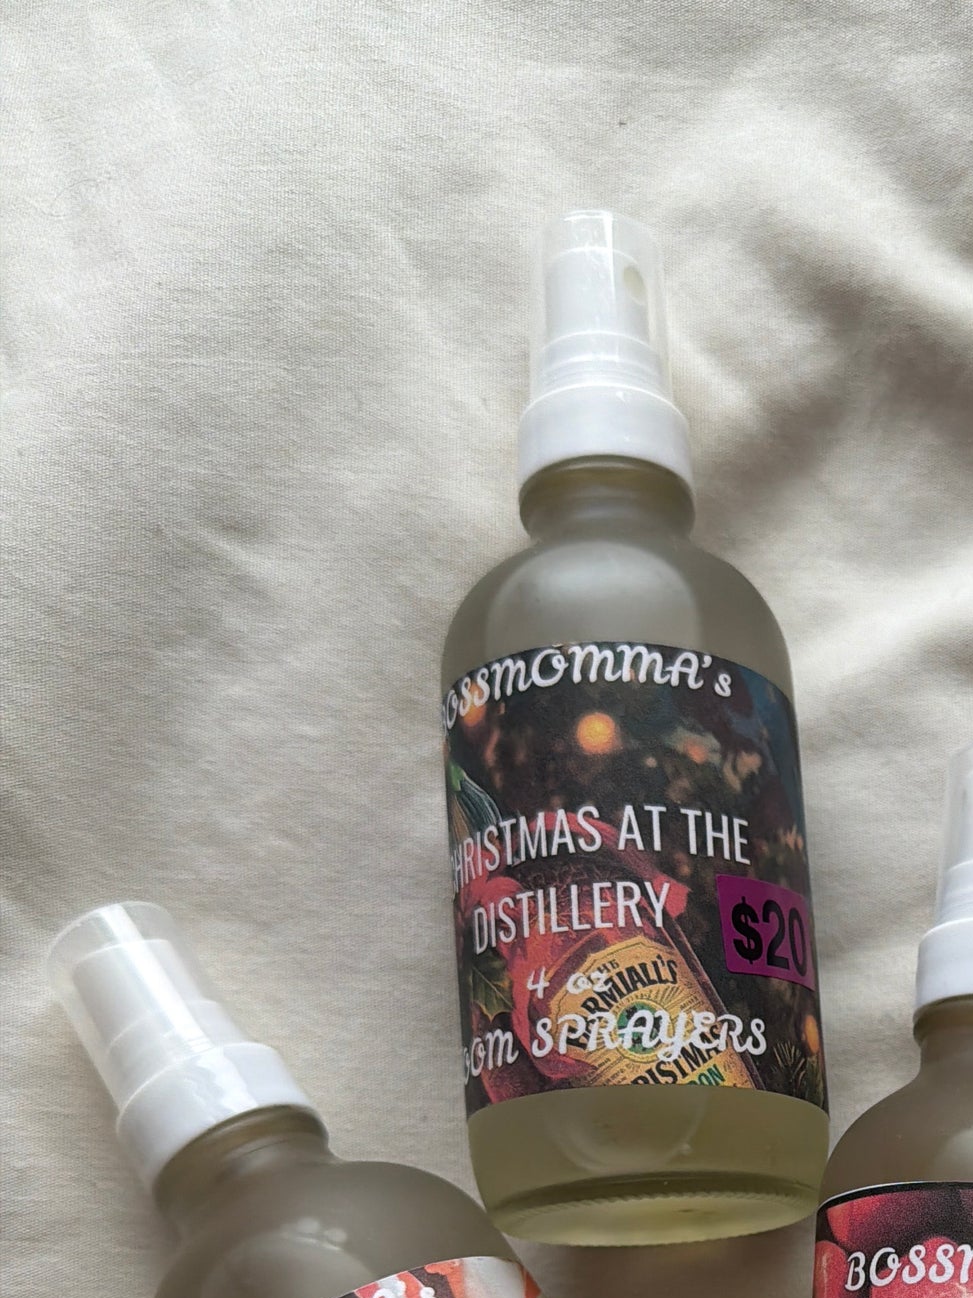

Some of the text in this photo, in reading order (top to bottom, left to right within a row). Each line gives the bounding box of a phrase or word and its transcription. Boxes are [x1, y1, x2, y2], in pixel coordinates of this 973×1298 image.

[442, 644, 732, 733] OSSMOMMA's
[451, 804, 752, 895] HRISTMAS AT THE
[473, 880, 670, 956] DISTILLERY
[731, 895, 808, 977] $20
[526, 966, 549, 999] 4
[532, 1009, 768, 1063] SPRAYERS
